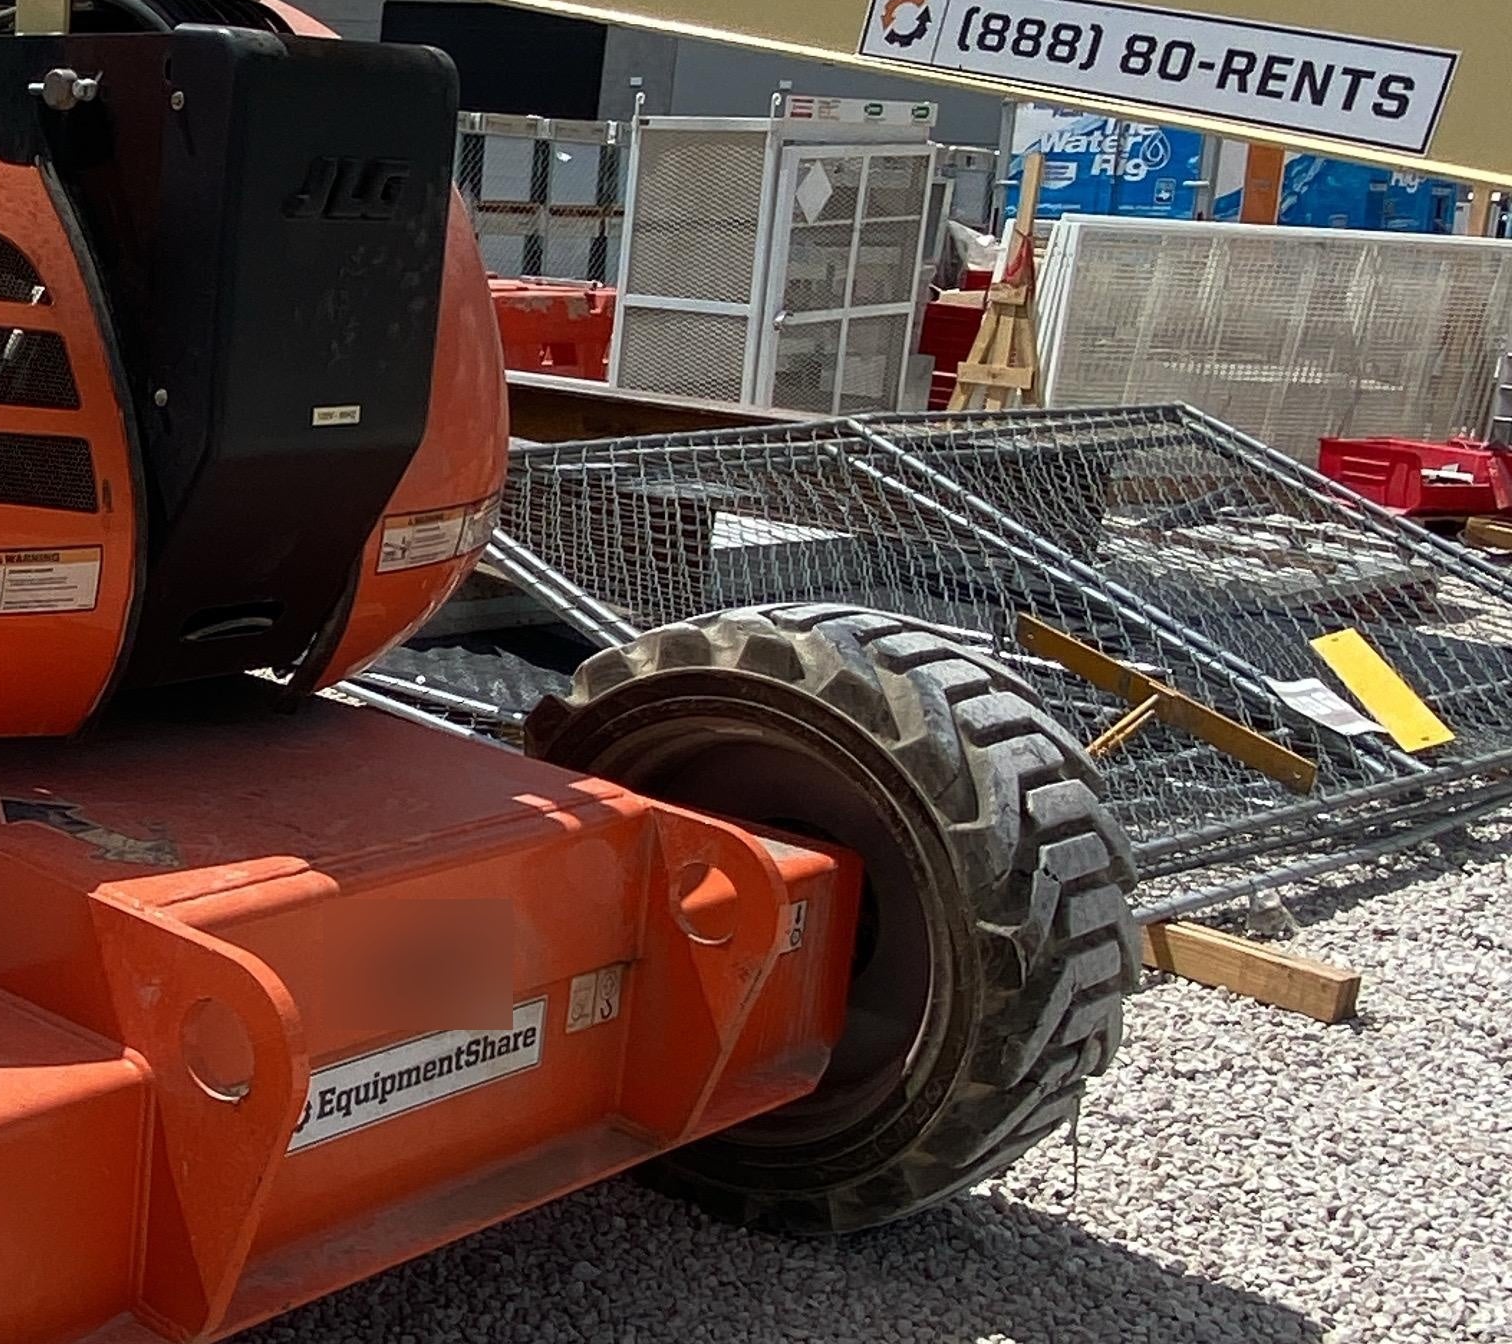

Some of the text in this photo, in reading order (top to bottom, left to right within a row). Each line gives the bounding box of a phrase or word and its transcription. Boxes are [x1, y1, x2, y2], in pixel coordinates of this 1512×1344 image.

[956, 7, 1417, 120] (888) 80-RENTS
[1040, 131, 1143, 154] Water
[1091, 154, 1148, 181] Rig
[317, 1026, 537, 1118] EquipmentShare
